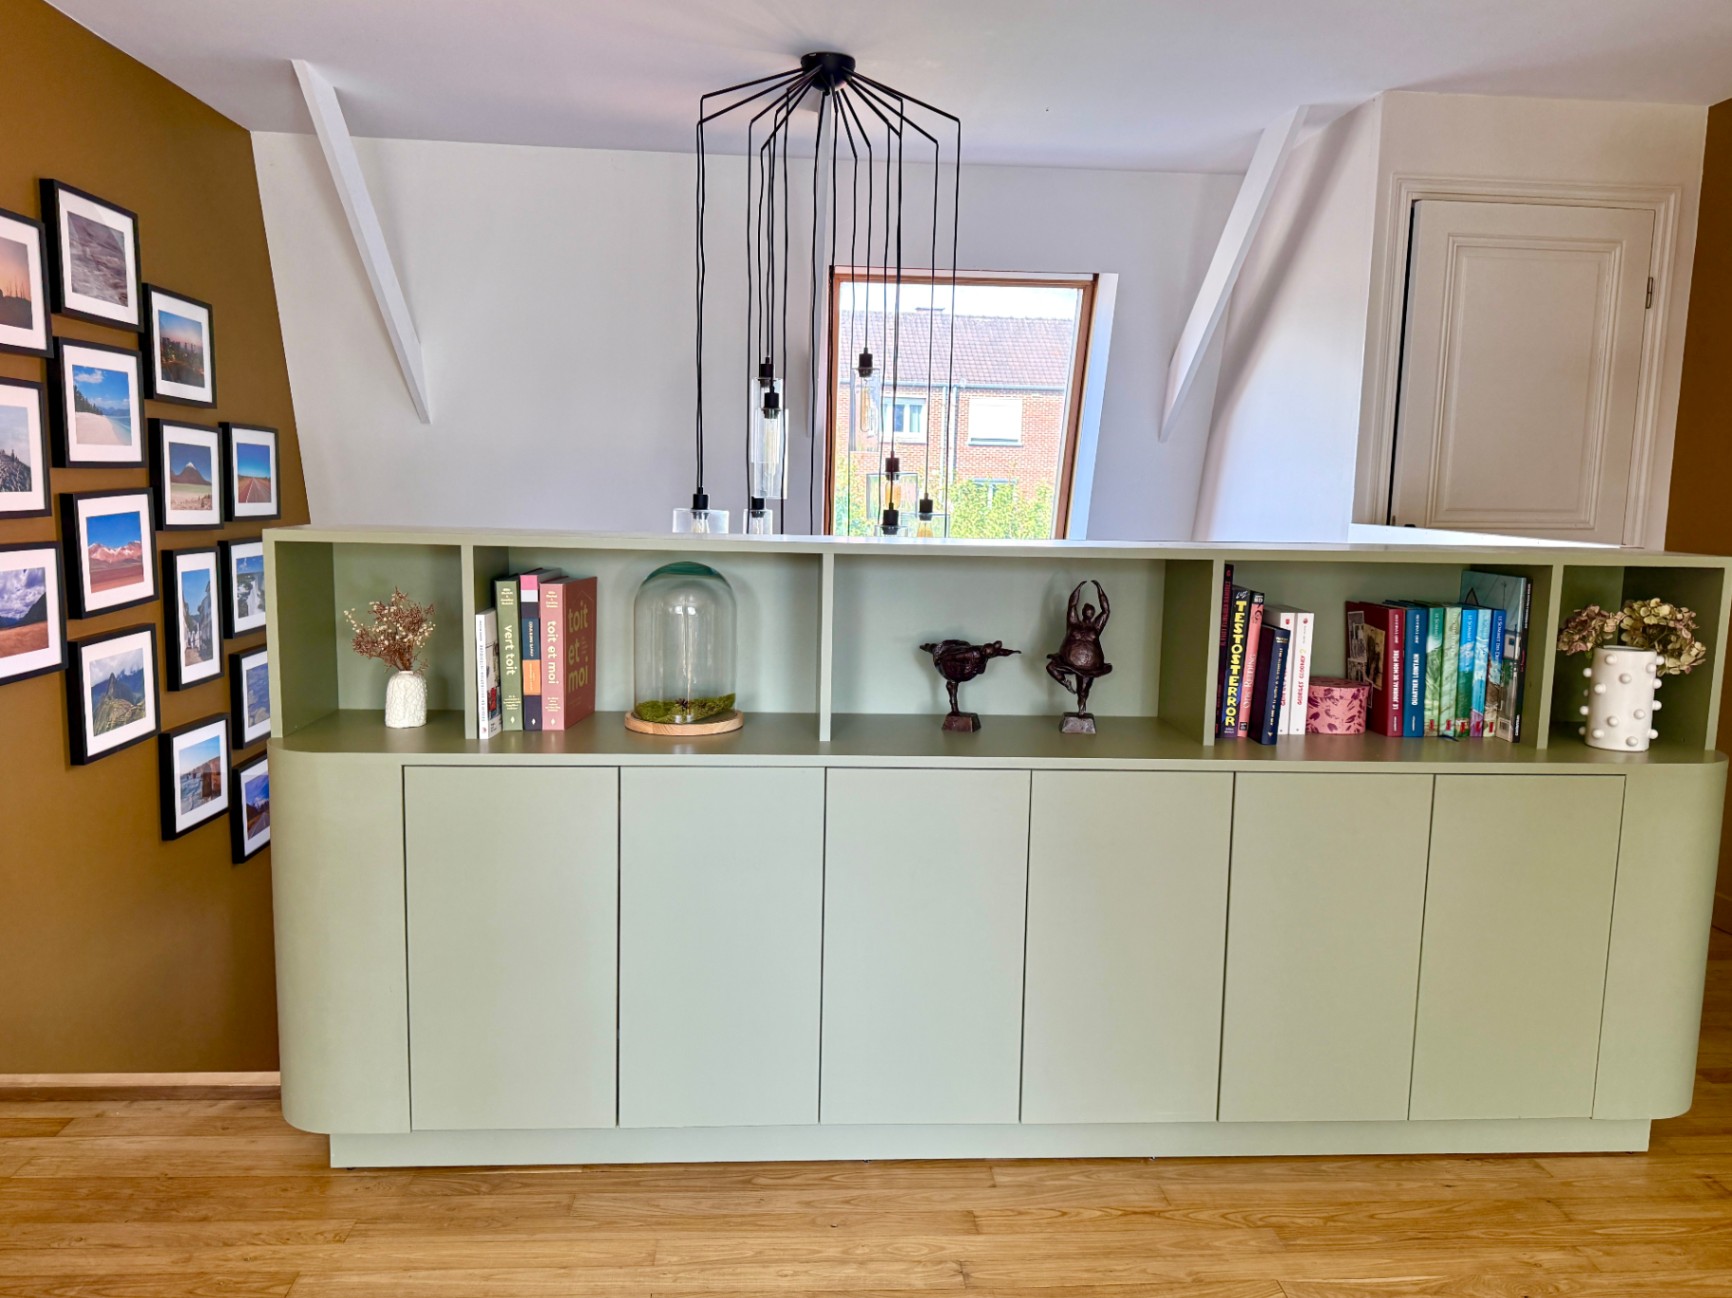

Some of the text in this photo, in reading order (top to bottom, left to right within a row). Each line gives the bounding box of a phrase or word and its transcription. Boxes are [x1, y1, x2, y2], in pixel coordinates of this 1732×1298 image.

[568, 601, 588, 633] toit
[547, 621, 559, 643] toit
[504, 625, 518, 675] vert toit
[547, 646, 557, 659] et
[568, 638, 580, 665] et
[1225, 600, 1247, 727] TESTOSTERROR
[548, 662, 559, 684] moi
[568, 656, 588, 693] moi
[1411, 679, 1419, 706] QUARTIER
